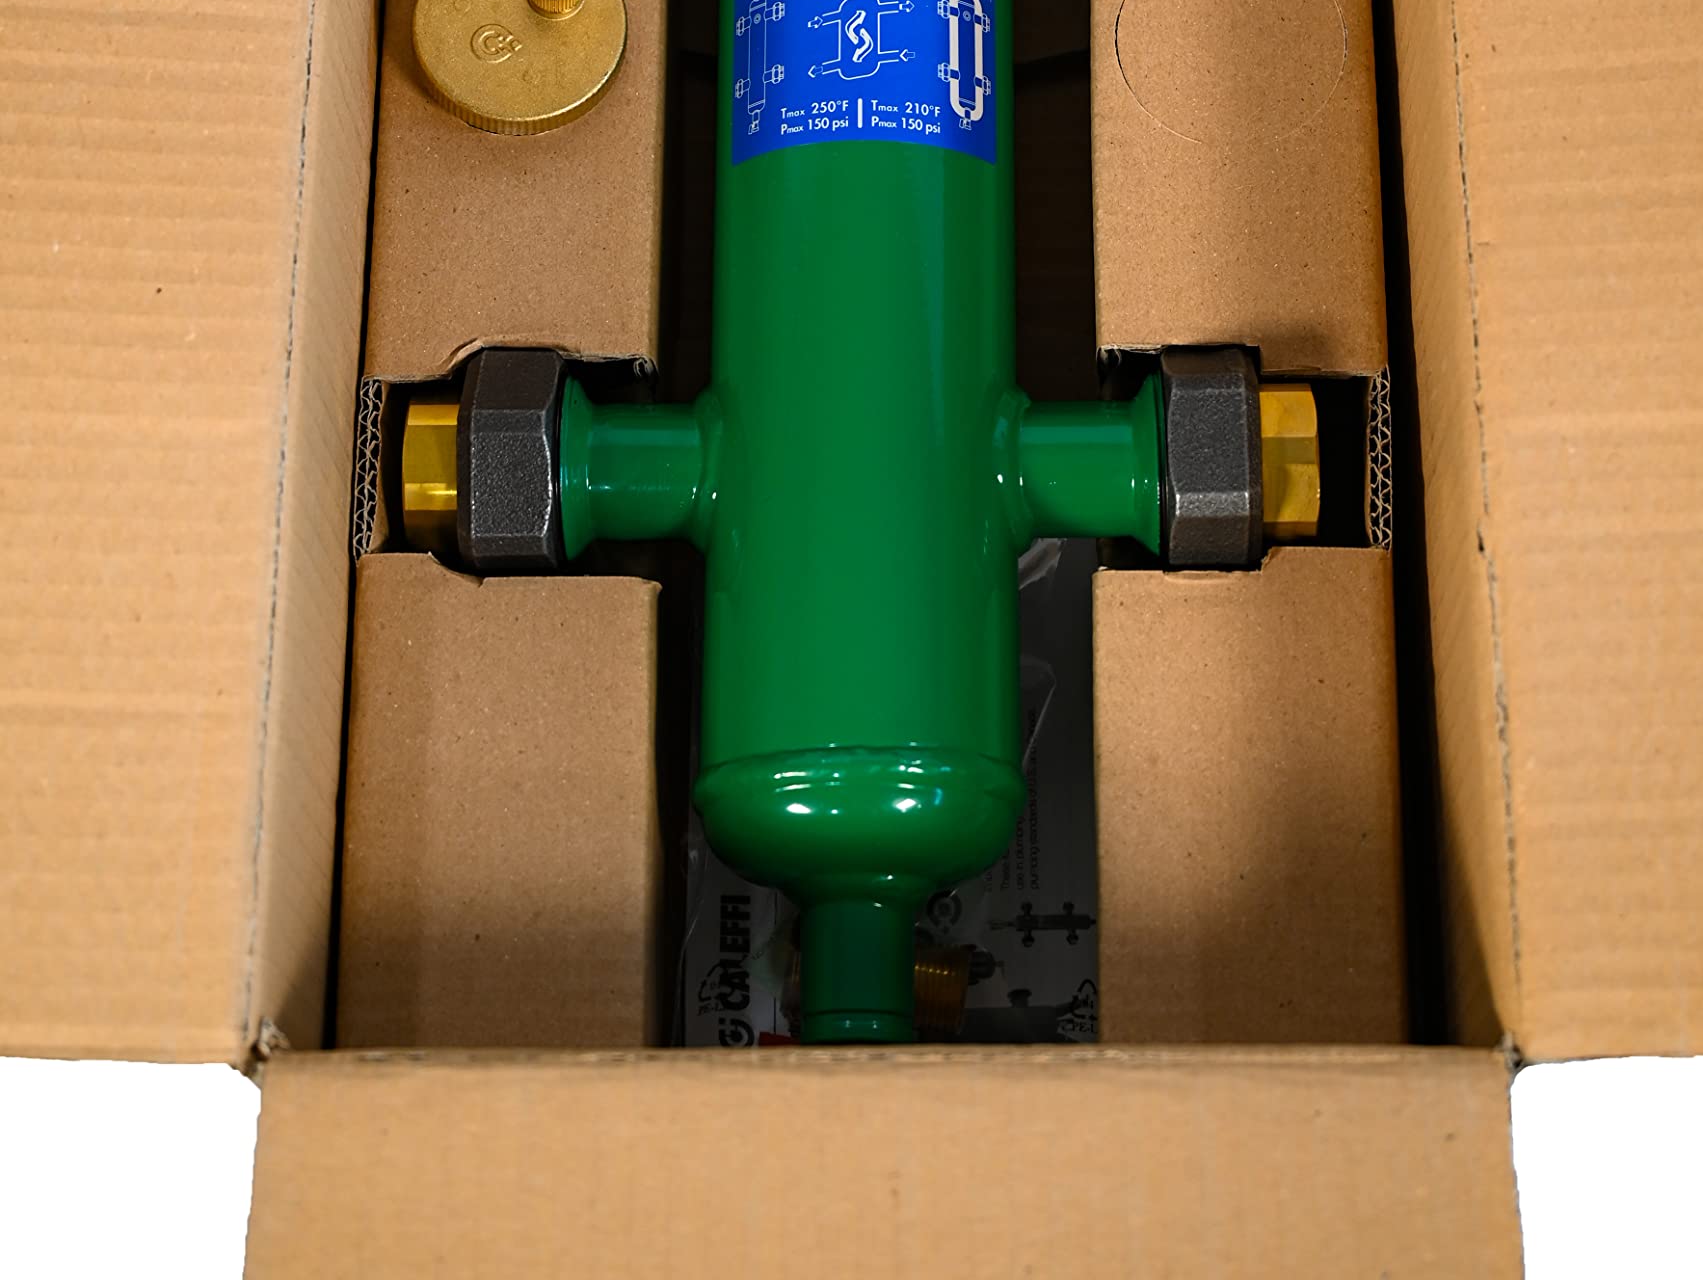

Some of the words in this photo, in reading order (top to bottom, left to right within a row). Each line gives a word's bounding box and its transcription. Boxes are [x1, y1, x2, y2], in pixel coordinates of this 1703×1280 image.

[780, 107, 805, 119] Tmax
[811, 100, 849, 115] 250°F
[871, 99, 899, 113] Tmax
[904, 101, 941, 118] 210°F
[780, 123, 804, 135] Pmax
[807, 117, 829, 130] 150
[832, 116, 849, 131] psi
[871, 116, 897, 129] Pmax
[901, 117, 923, 131] 150
[925, 122, 941, 135] psi
[719, 895, 750, 1011] CALEFFI
